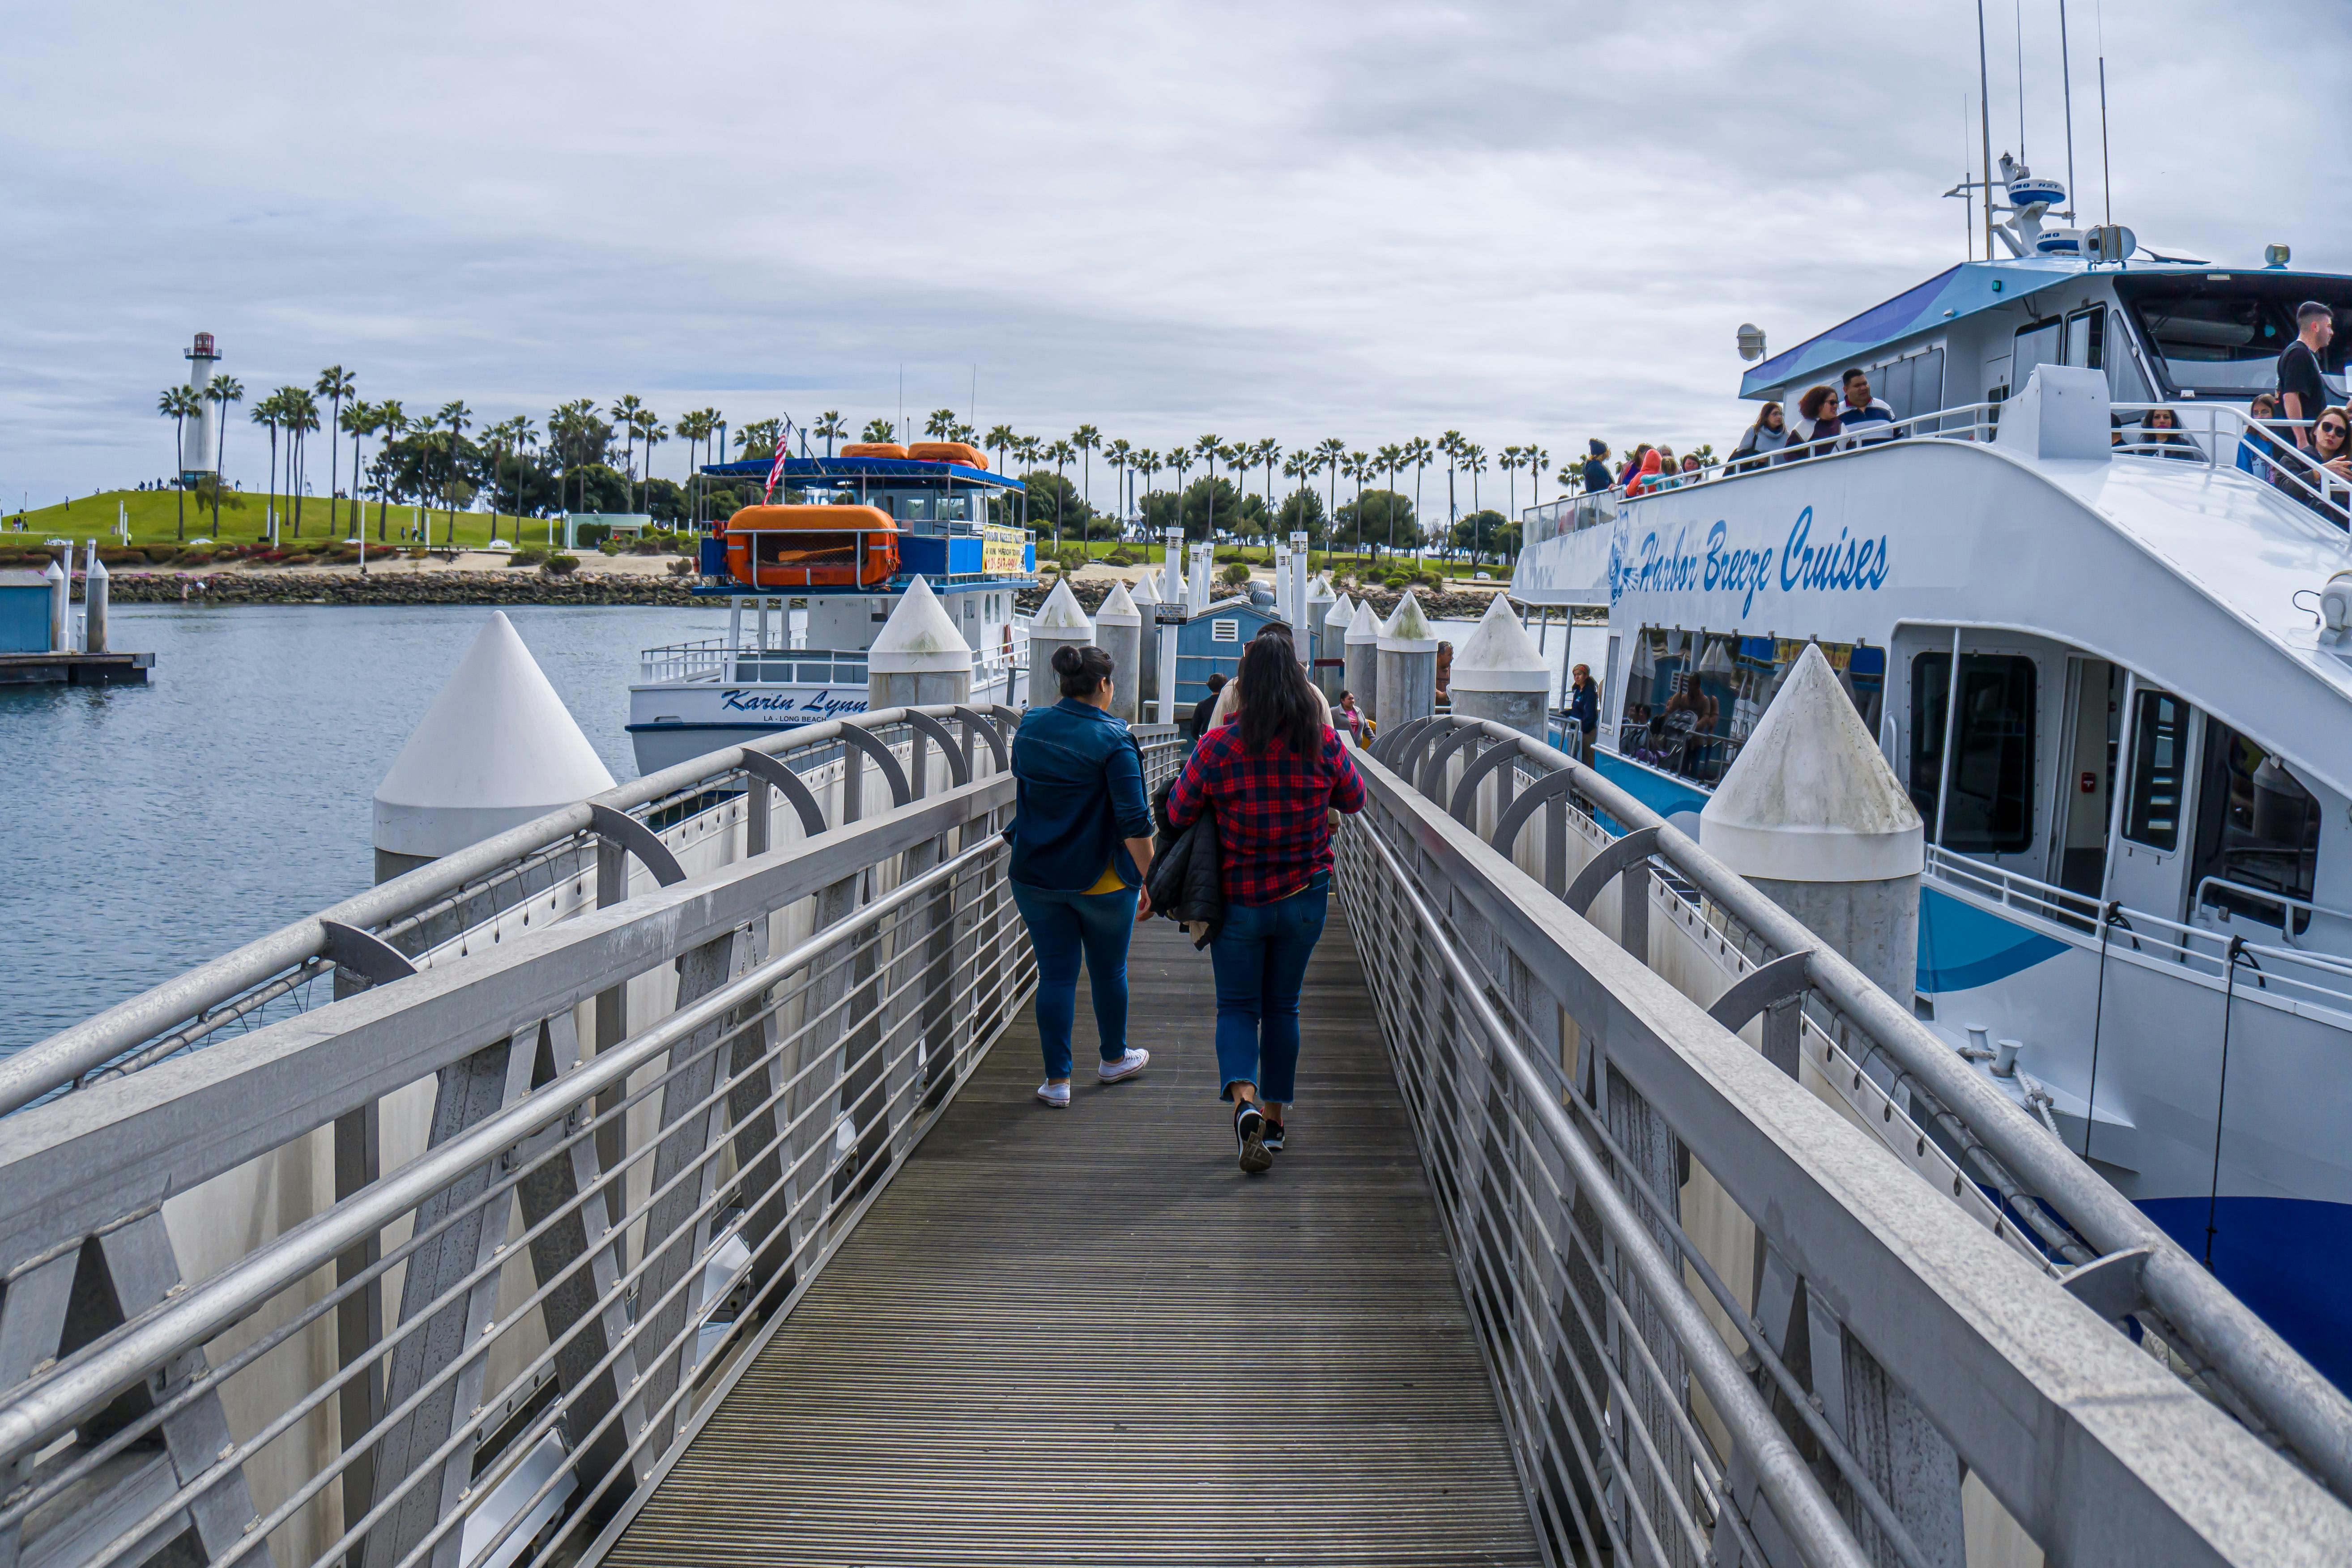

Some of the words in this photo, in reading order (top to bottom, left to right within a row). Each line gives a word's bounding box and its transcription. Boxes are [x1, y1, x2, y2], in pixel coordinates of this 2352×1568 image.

[1640, 526, 1697, 592] Harbor
[1704, 519, 1773, 619] Breeze
[1781, 505, 1890, 592] Cruises
[721, 689, 795, 711] Karin
[800, 690, 869, 718] Lynn
